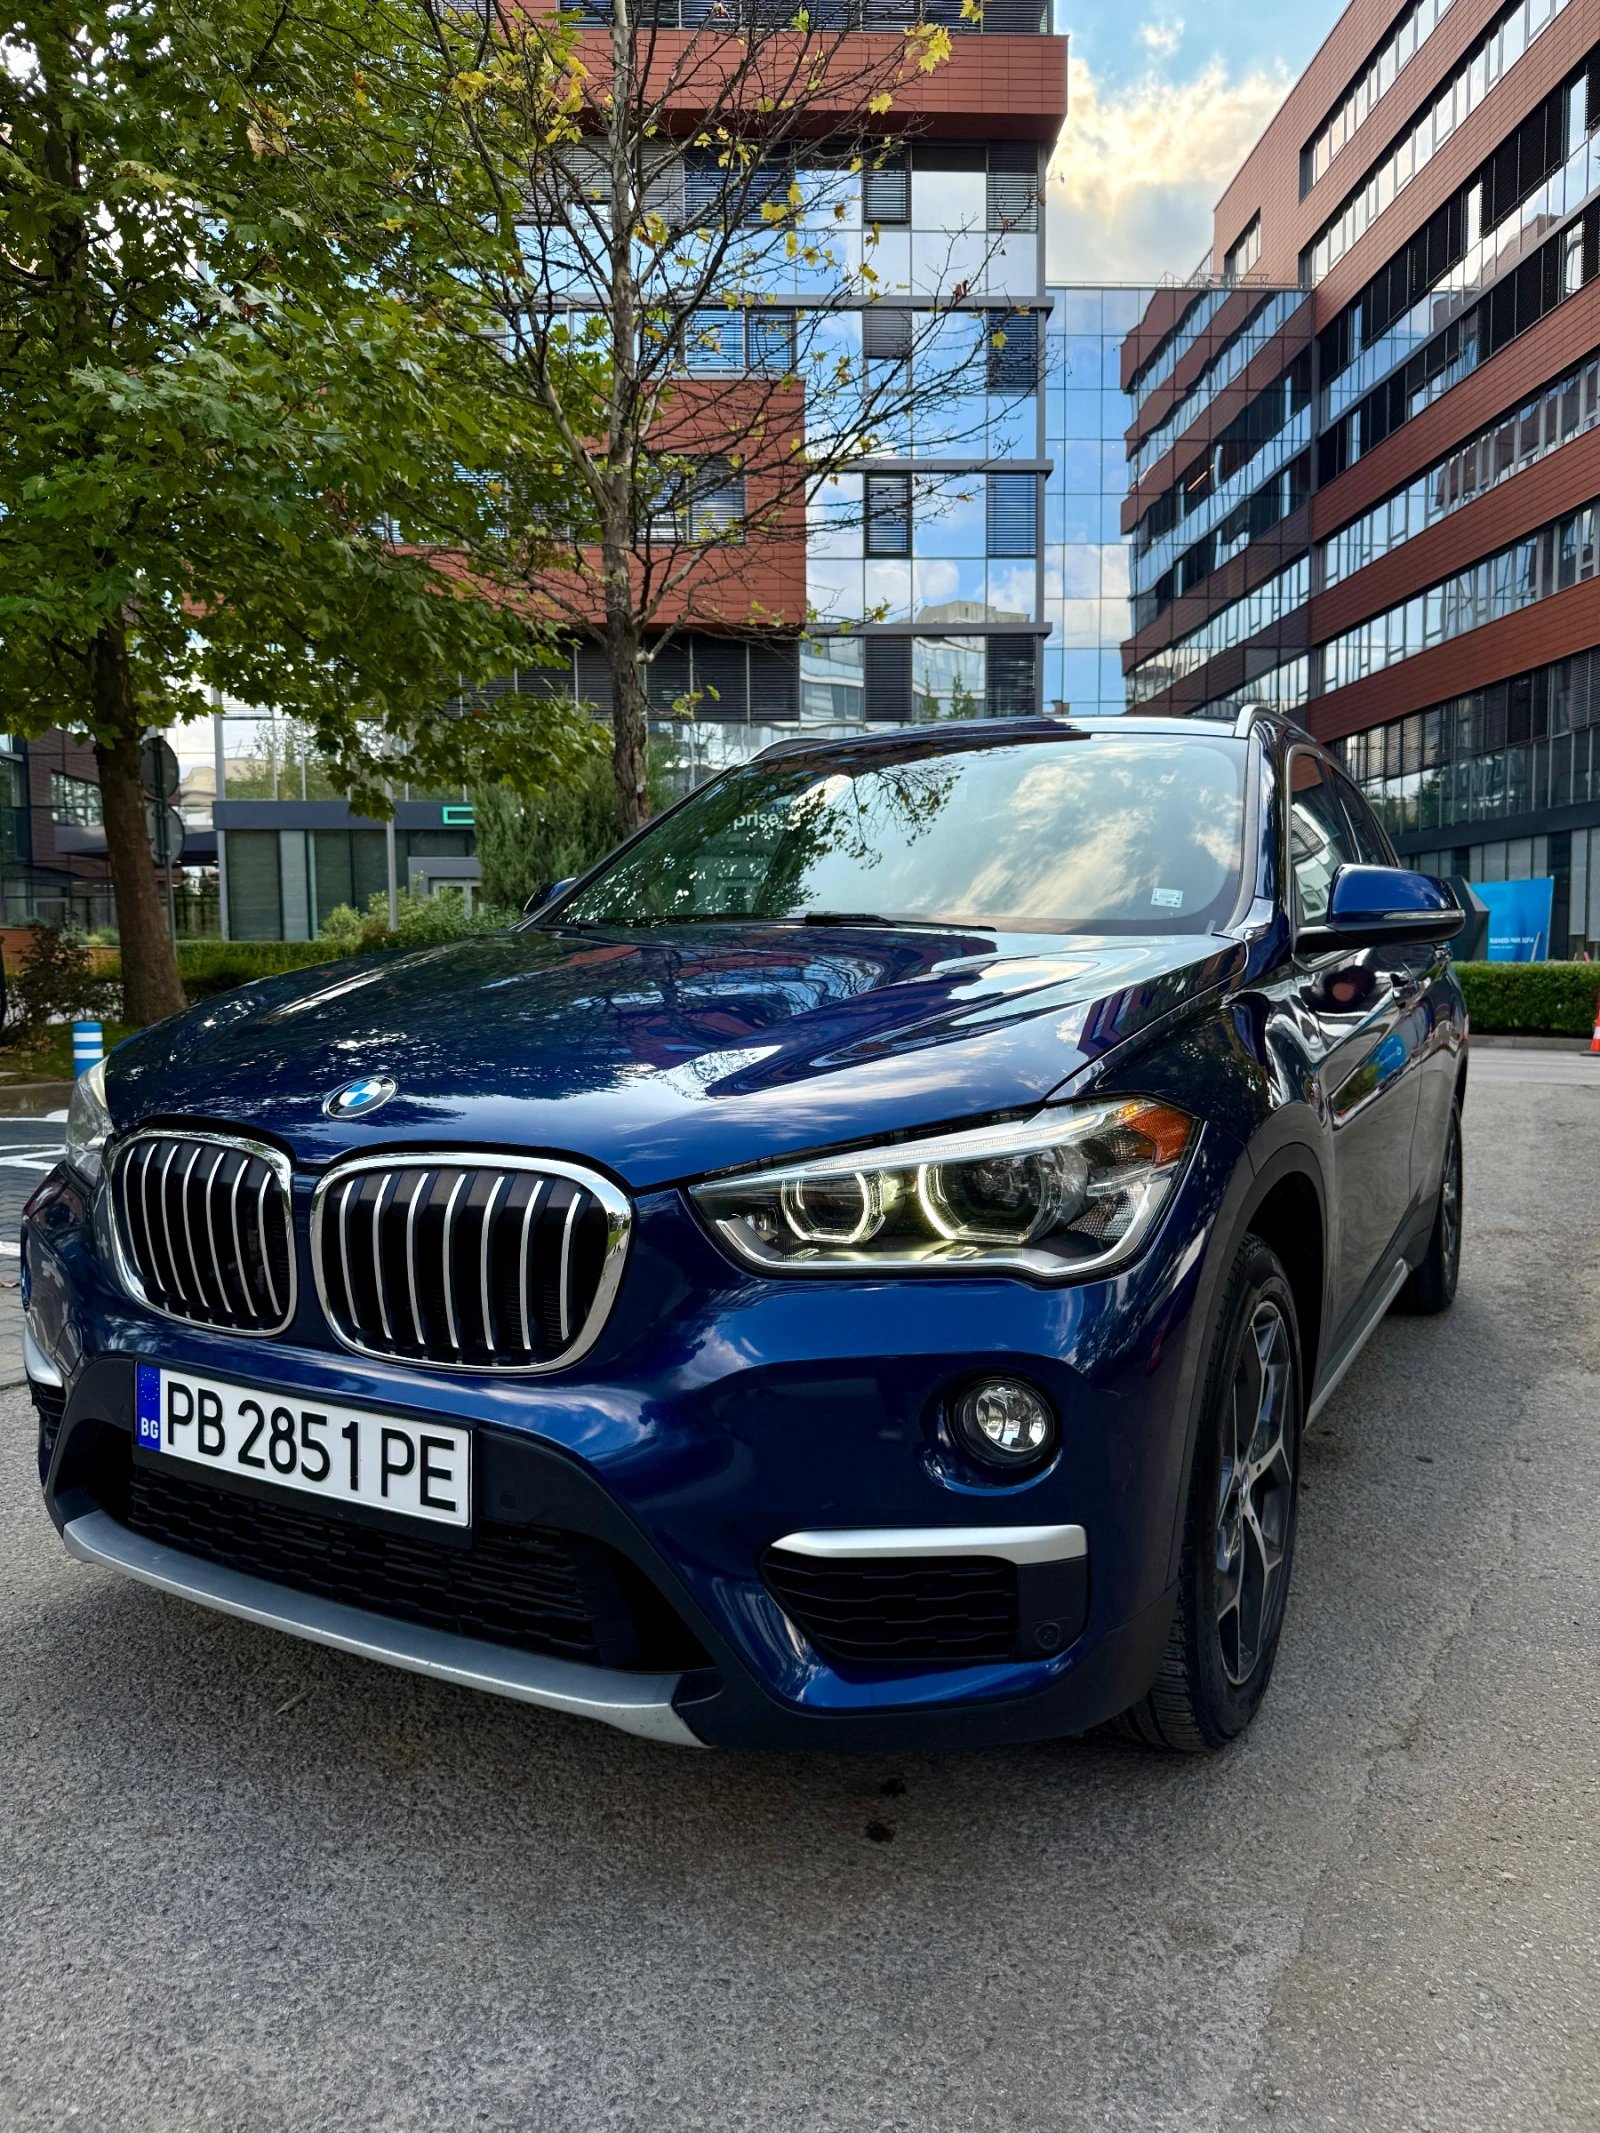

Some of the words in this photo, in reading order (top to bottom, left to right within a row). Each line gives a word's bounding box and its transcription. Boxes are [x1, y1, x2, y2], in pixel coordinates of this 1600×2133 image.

[141, 1418, 159, 1439] BG
[167, 1381, 226, 1456] PB
[237, 1399, 359, 1491] 2851
[381, 1427, 457, 1512] PE
